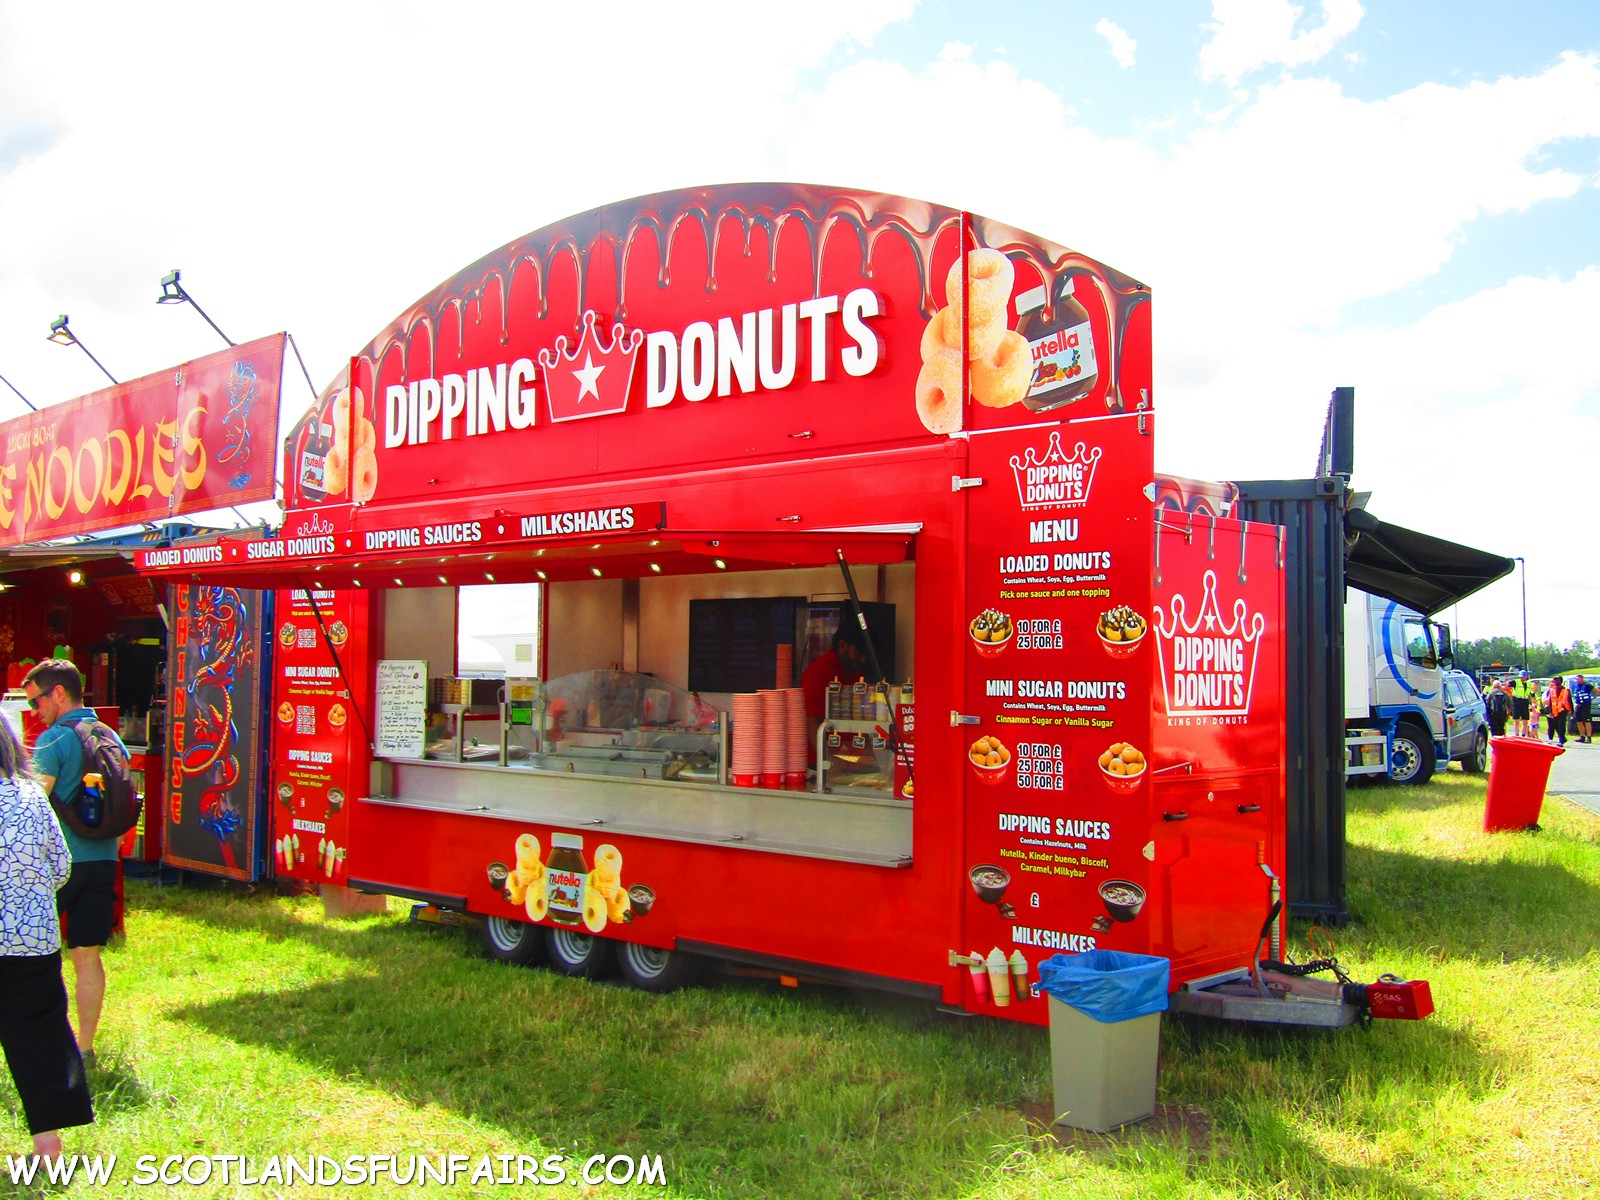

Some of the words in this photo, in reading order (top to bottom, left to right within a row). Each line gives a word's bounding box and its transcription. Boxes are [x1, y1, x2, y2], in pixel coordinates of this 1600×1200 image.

[1031, 330, 1079, 361] utella
[385, 357, 537, 449] DIPPING
[646, 288, 881, 410] DONUTS
[24, 406, 208, 521] NOODLES
[1026, 463, 1083, 485] DIPPING
[1026, 481, 1083, 502] DONUTS
[1056, 502, 1087, 510] DONUTS
[145, 550, 181, 567] LOADED
[183, 546, 222, 564] DONUTS
[247, 540, 284, 559] SUGAR
[288, 536, 335, 557] DONUTS
[365, 528, 420, 550] DIPPING
[424, 522, 482, 545] SAUCES
[521, 506, 634, 537] MILKSHAKES
[1029, 518, 1079, 544] MENU
[999, 554, 1049, 574] LOADED
[1053, 551, 1111, 571] DONUTS
[1003, 577, 1026, 585] Contains
[1027, 576, 1046, 584] Wheat,
[1063, 575, 1075, 584] Egg,
[1076, 573, 1107, 582] Buttermilk
[1000, 590, 1015, 599] Pick
[1030, 590, 1051, 598] sauce
[1052, 588, 1065, 597] and
[1067, 589, 1080, 597] one
[1082, 587, 1110, 598] topping
[1017, 619, 1030, 634] 10
[1032, 619, 1050, 634] FOR
[1053, 619, 1061, 633] £
[1017, 636, 1030, 649] 25
[1033, 635, 1051, 649] FOR
[1055, 635, 1063, 649] £
[1174, 636, 1244, 672] DIPPING
[986, 679, 1013, 697] MINI
[1018, 680, 1063, 698] SUGAR
[1068, 681, 1126, 700] DONUTS
[1174, 673, 1244, 707] DONUTS
[170, 584, 189, 824] CHINESE
[1003, 702, 1026, 710] Contains
[1026, 702, 1046, 711] Wheat,
[1047, 703, 1062, 711] Soya,
[1062, 704, 1075, 712] Egg,
[1075, 704, 1107, 712] Buttermilk
[995, 714, 1030, 724] Cinnamon
[1031, 715, 1052, 726] Sugar
[1054, 717, 1062, 725] or
[1064, 716, 1090, 727] Vanilla
[1091, 717, 1115, 729] Sugar
[1167, 717, 1191, 727] KING
[1196, 717, 1208, 726] OF
[1212, 716, 1248, 725] DONUTS
[310, 751, 333, 764] SAUCES
[1017, 743, 1029, 757] 10
[1032, 743, 1051, 758] FOR
[1053, 744, 1062, 758] £
[1017, 759, 1031, 772] 25
[1033, 759, 1052, 774] FOR
[1055, 760, 1063, 775] £
[1017, 774, 1031, 788] 50
[1033, 775, 1053, 790] FOR
[1055, 776, 1063, 790] £
[999, 813, 1051, 835] DIPPING
[1055, 818, 1111, 840] SAUCES
[1020, 836, 1044, 846] Contains
[1044, 839, 1073, 849] Hazelnuts,
[1074, 842, 1087, 850] Milk
[1000, 848, 1027, 860] Nutella,
[1029, 851, 1053, 862] Kinder
[1054, 853, 1079, 866] bueno,
[1080, 856, 1109, 869] Biscoff,
[1020, 862, 1052, 875] Caramel,
[1053, 866, 1087, 879] Milkybar
[549, 871, 581, 888] nutella
[1030, 892, 1040, 908] £
[1012, 925, 1096, 953] MILKSHAKES
[1383, 994, 1402, 1002] SAS
